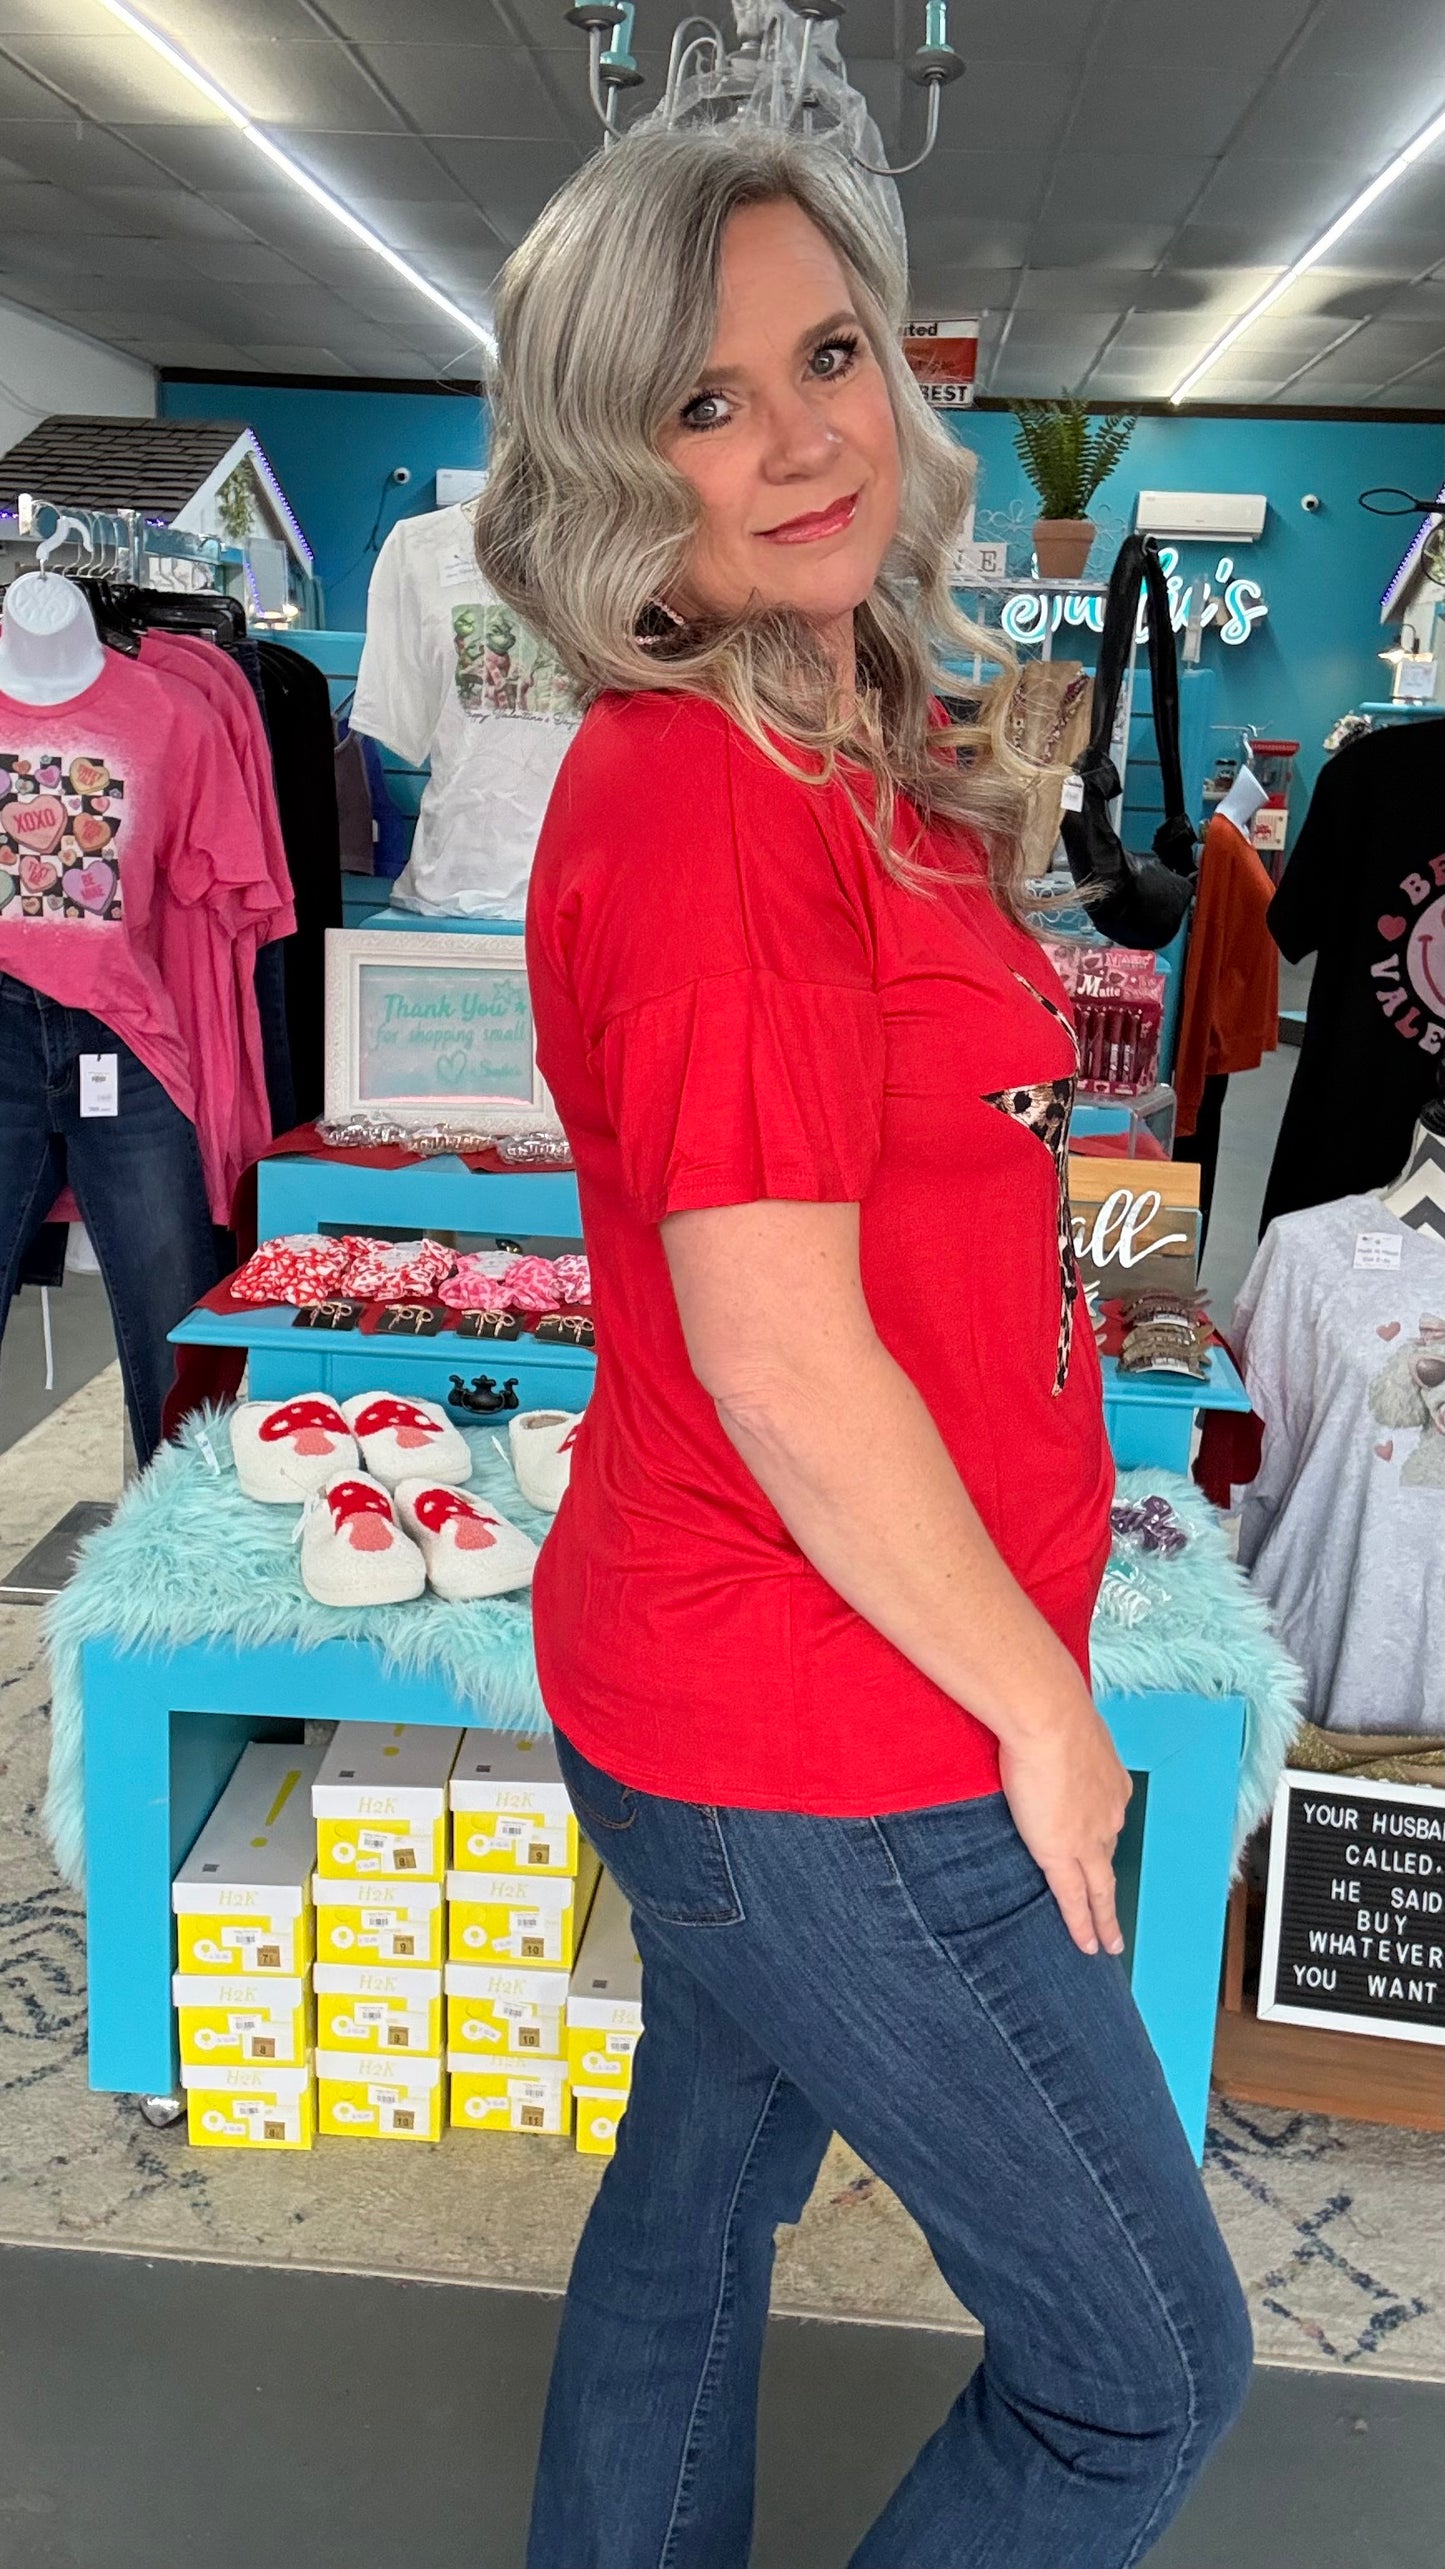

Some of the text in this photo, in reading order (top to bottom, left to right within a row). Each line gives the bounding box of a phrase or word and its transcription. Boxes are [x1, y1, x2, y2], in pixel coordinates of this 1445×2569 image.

[921, 385, 968, 401] BEST
[13, 808, 57, 834] XOXO
[1077, 973, 1121, 998] Matte
[384, 993, 507, 1023] Thank You
[375, 1020, 526, 1050] for shopping small
[1303, 1802, 1445, 1841] YOUR HUSBA
[1330, 1879, 1443, 1914] HE SAID
[1356, 1909, 1408, 1935] BUY
[1308, 1930, 1443, 1969] WHATEVER
[1292, 1964, 1438, 2004] YOU WANT
